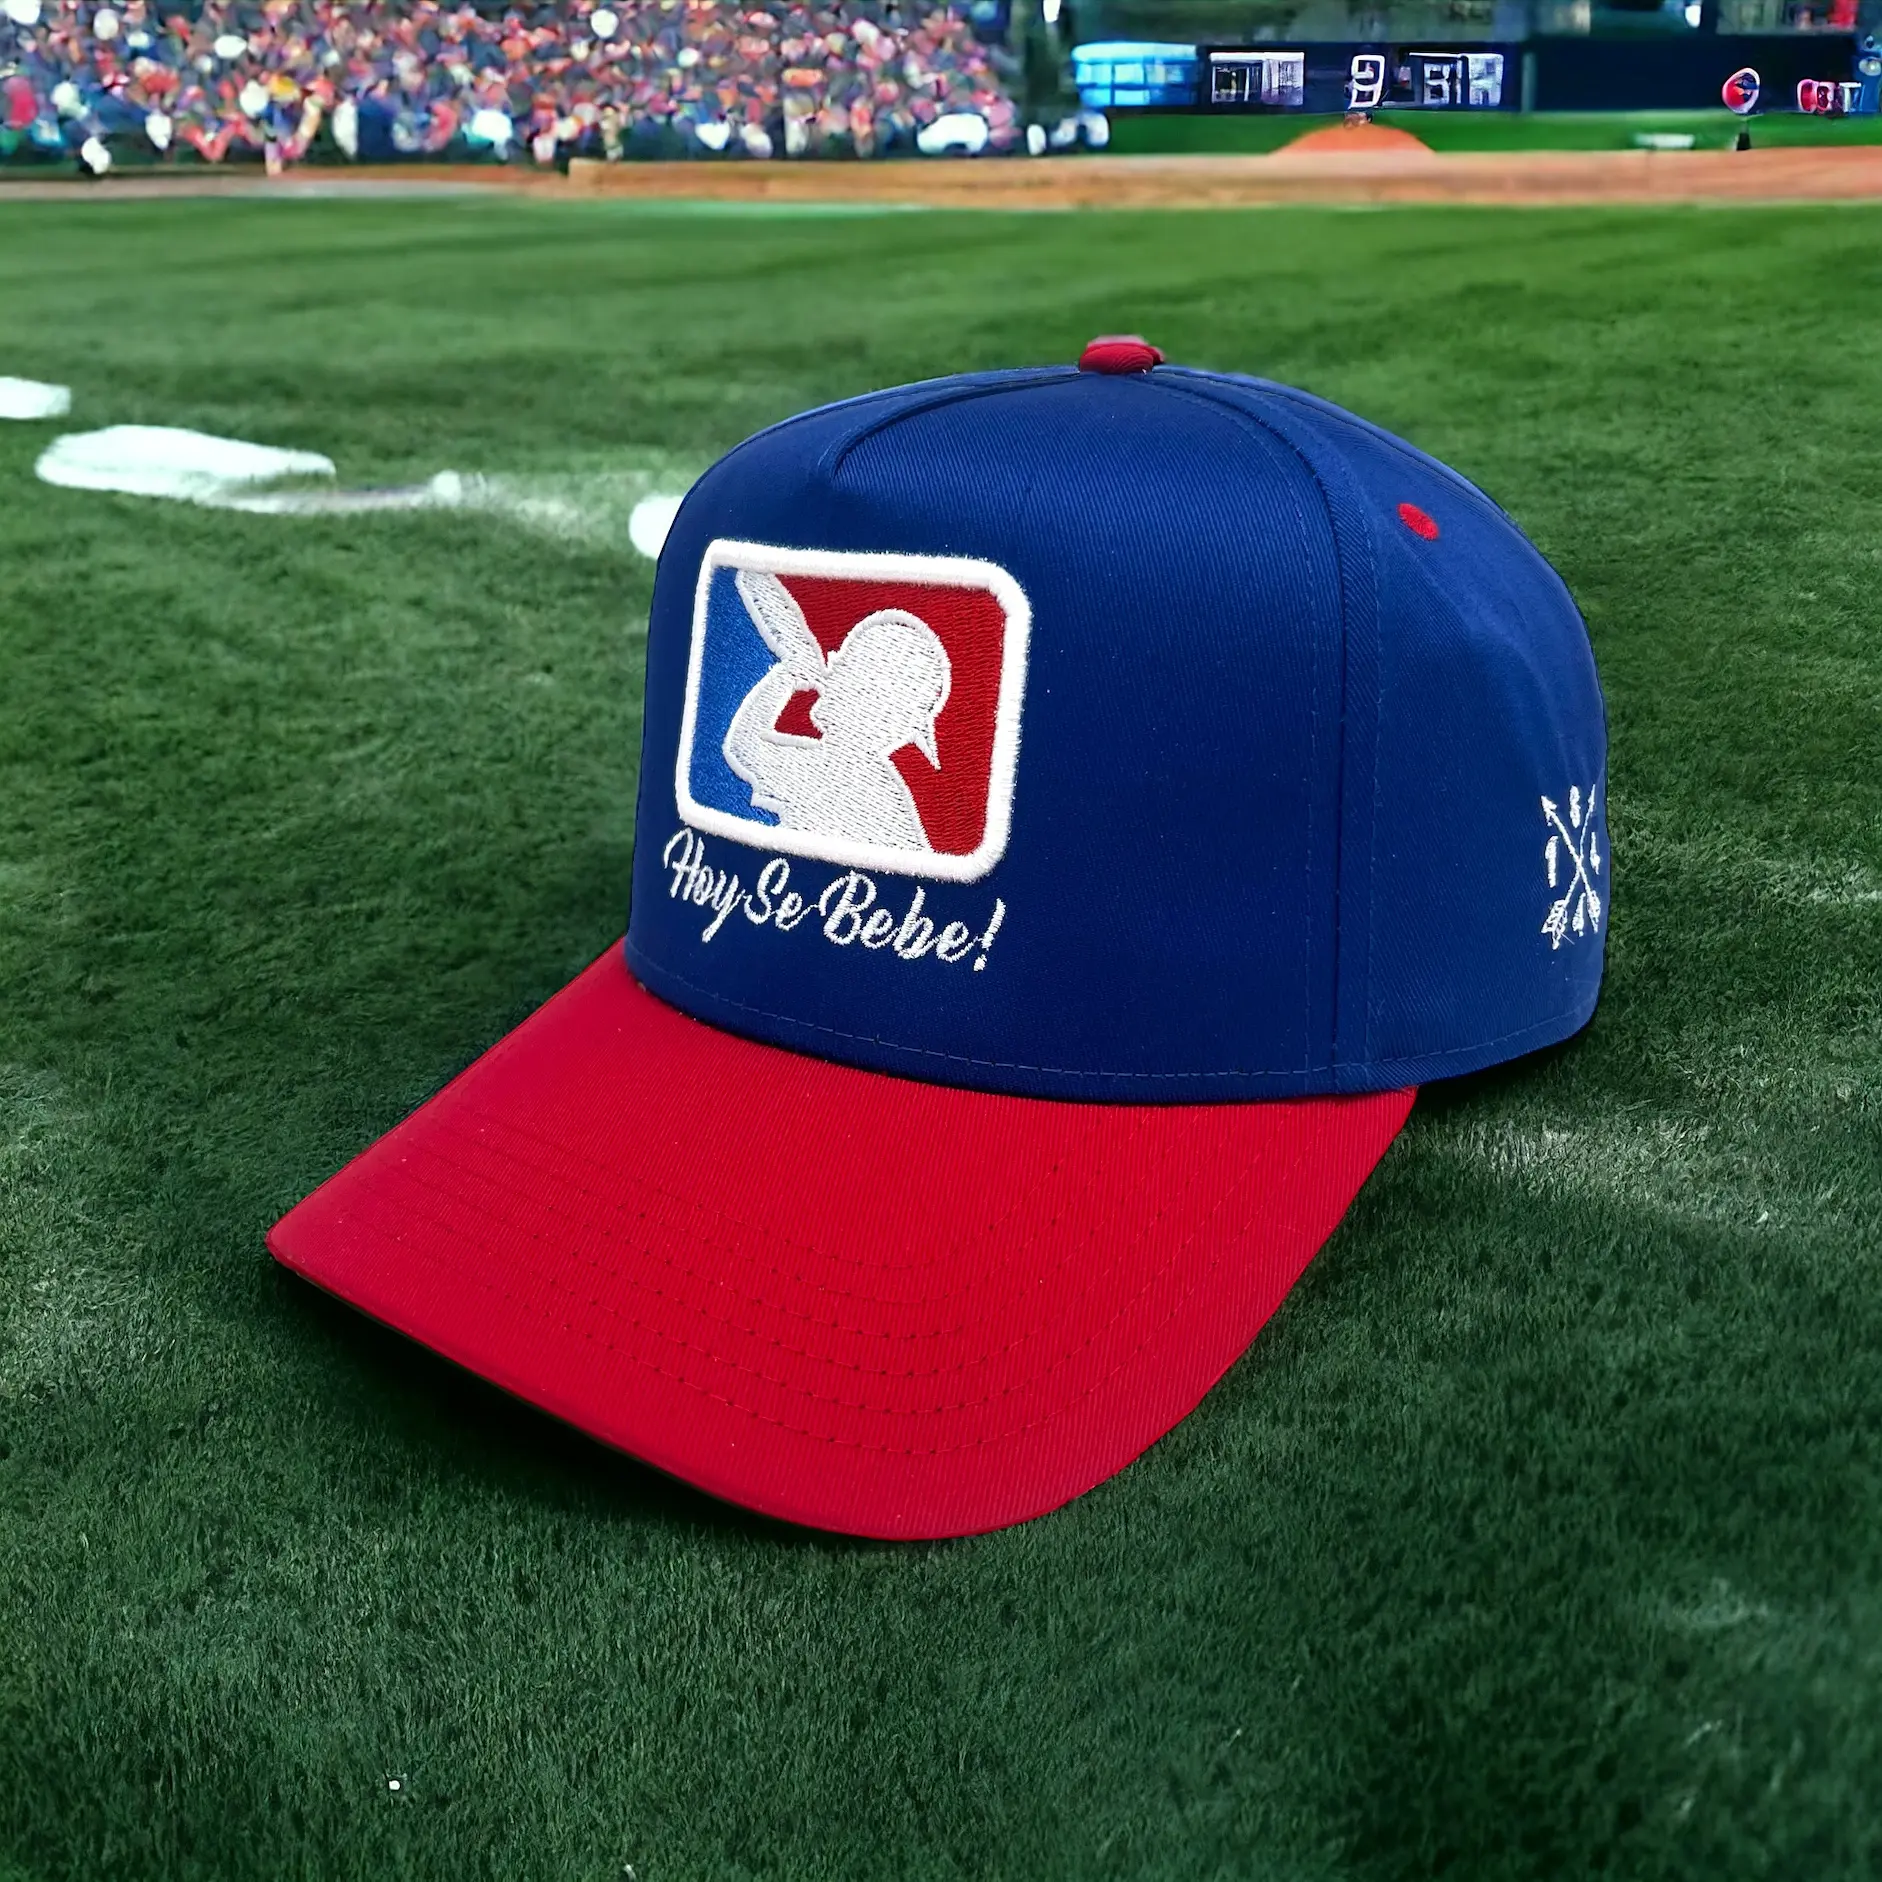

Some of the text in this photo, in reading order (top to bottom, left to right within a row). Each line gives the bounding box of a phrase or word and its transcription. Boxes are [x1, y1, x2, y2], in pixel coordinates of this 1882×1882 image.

[663, 827, 1006, 972] Hoy Se Bebe!
